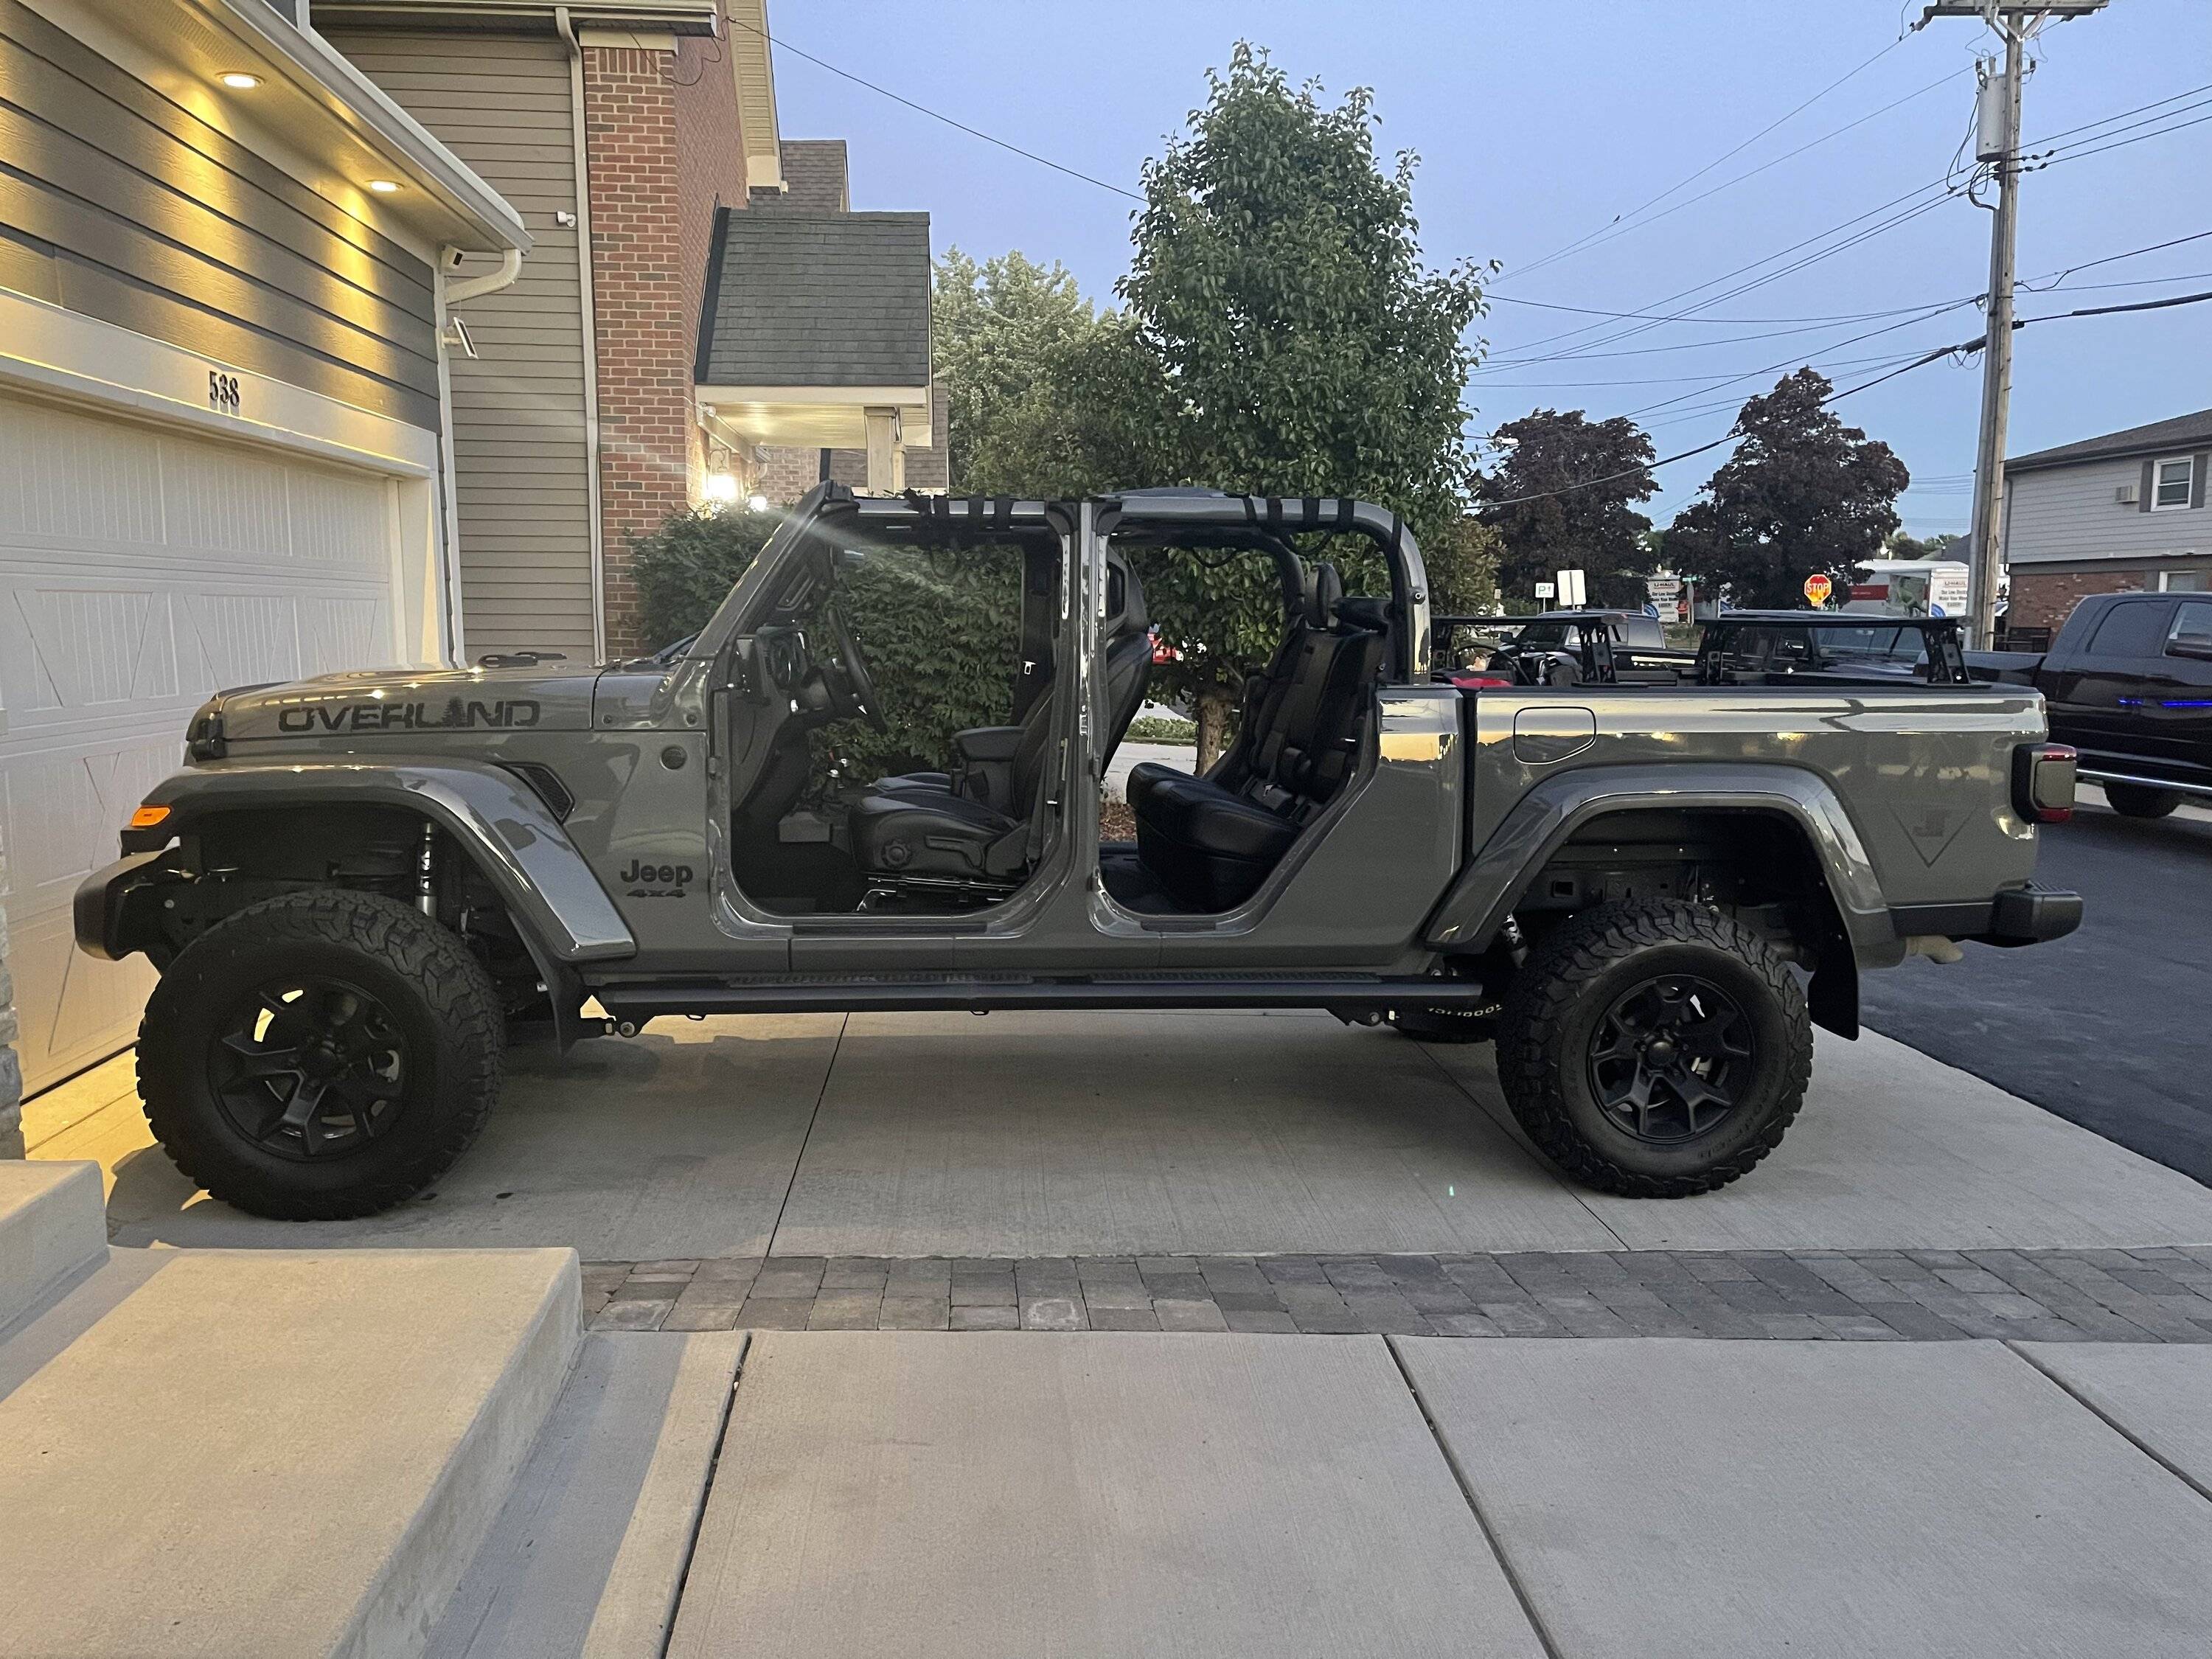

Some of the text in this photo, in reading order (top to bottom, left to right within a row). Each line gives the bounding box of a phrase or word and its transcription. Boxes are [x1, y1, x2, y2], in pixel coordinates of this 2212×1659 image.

[209, 371, 240, 406] 538
[1806, 582, 1829, 593] STOP
[278, 697, 541, 732] OVERLAND
[620, 859, 693, 887] Jeep
